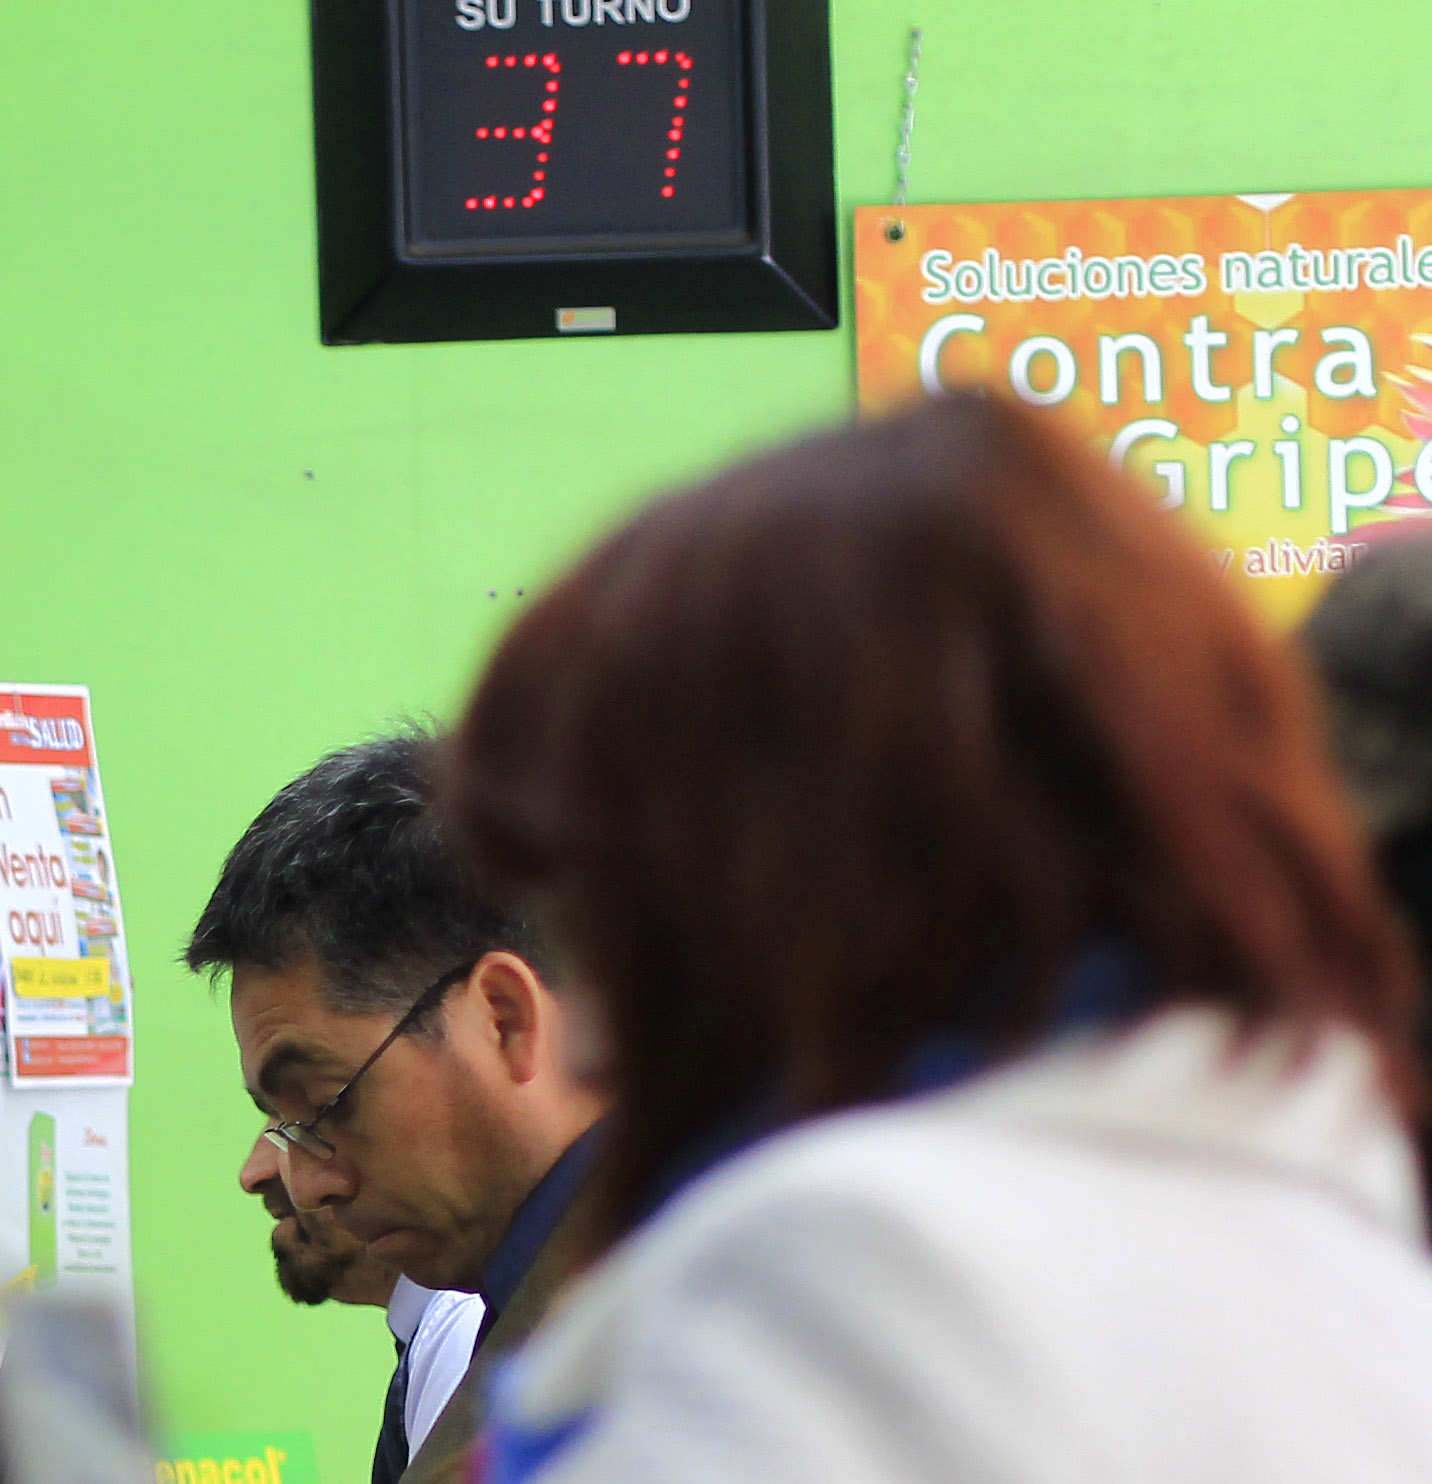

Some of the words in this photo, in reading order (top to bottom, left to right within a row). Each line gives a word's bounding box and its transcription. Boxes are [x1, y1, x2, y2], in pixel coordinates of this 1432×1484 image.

[455, 0, 517, 31] SU
[540, 0, 691, 27] TURNO
[465, 51, 693, 210] 37
[920, 246, 1206, 302] Soluciones
[919, 313, 1377, 406] Contra
[1109, 415, 1432, 535] Grip
[26, 716, 84, 749] SALUD
